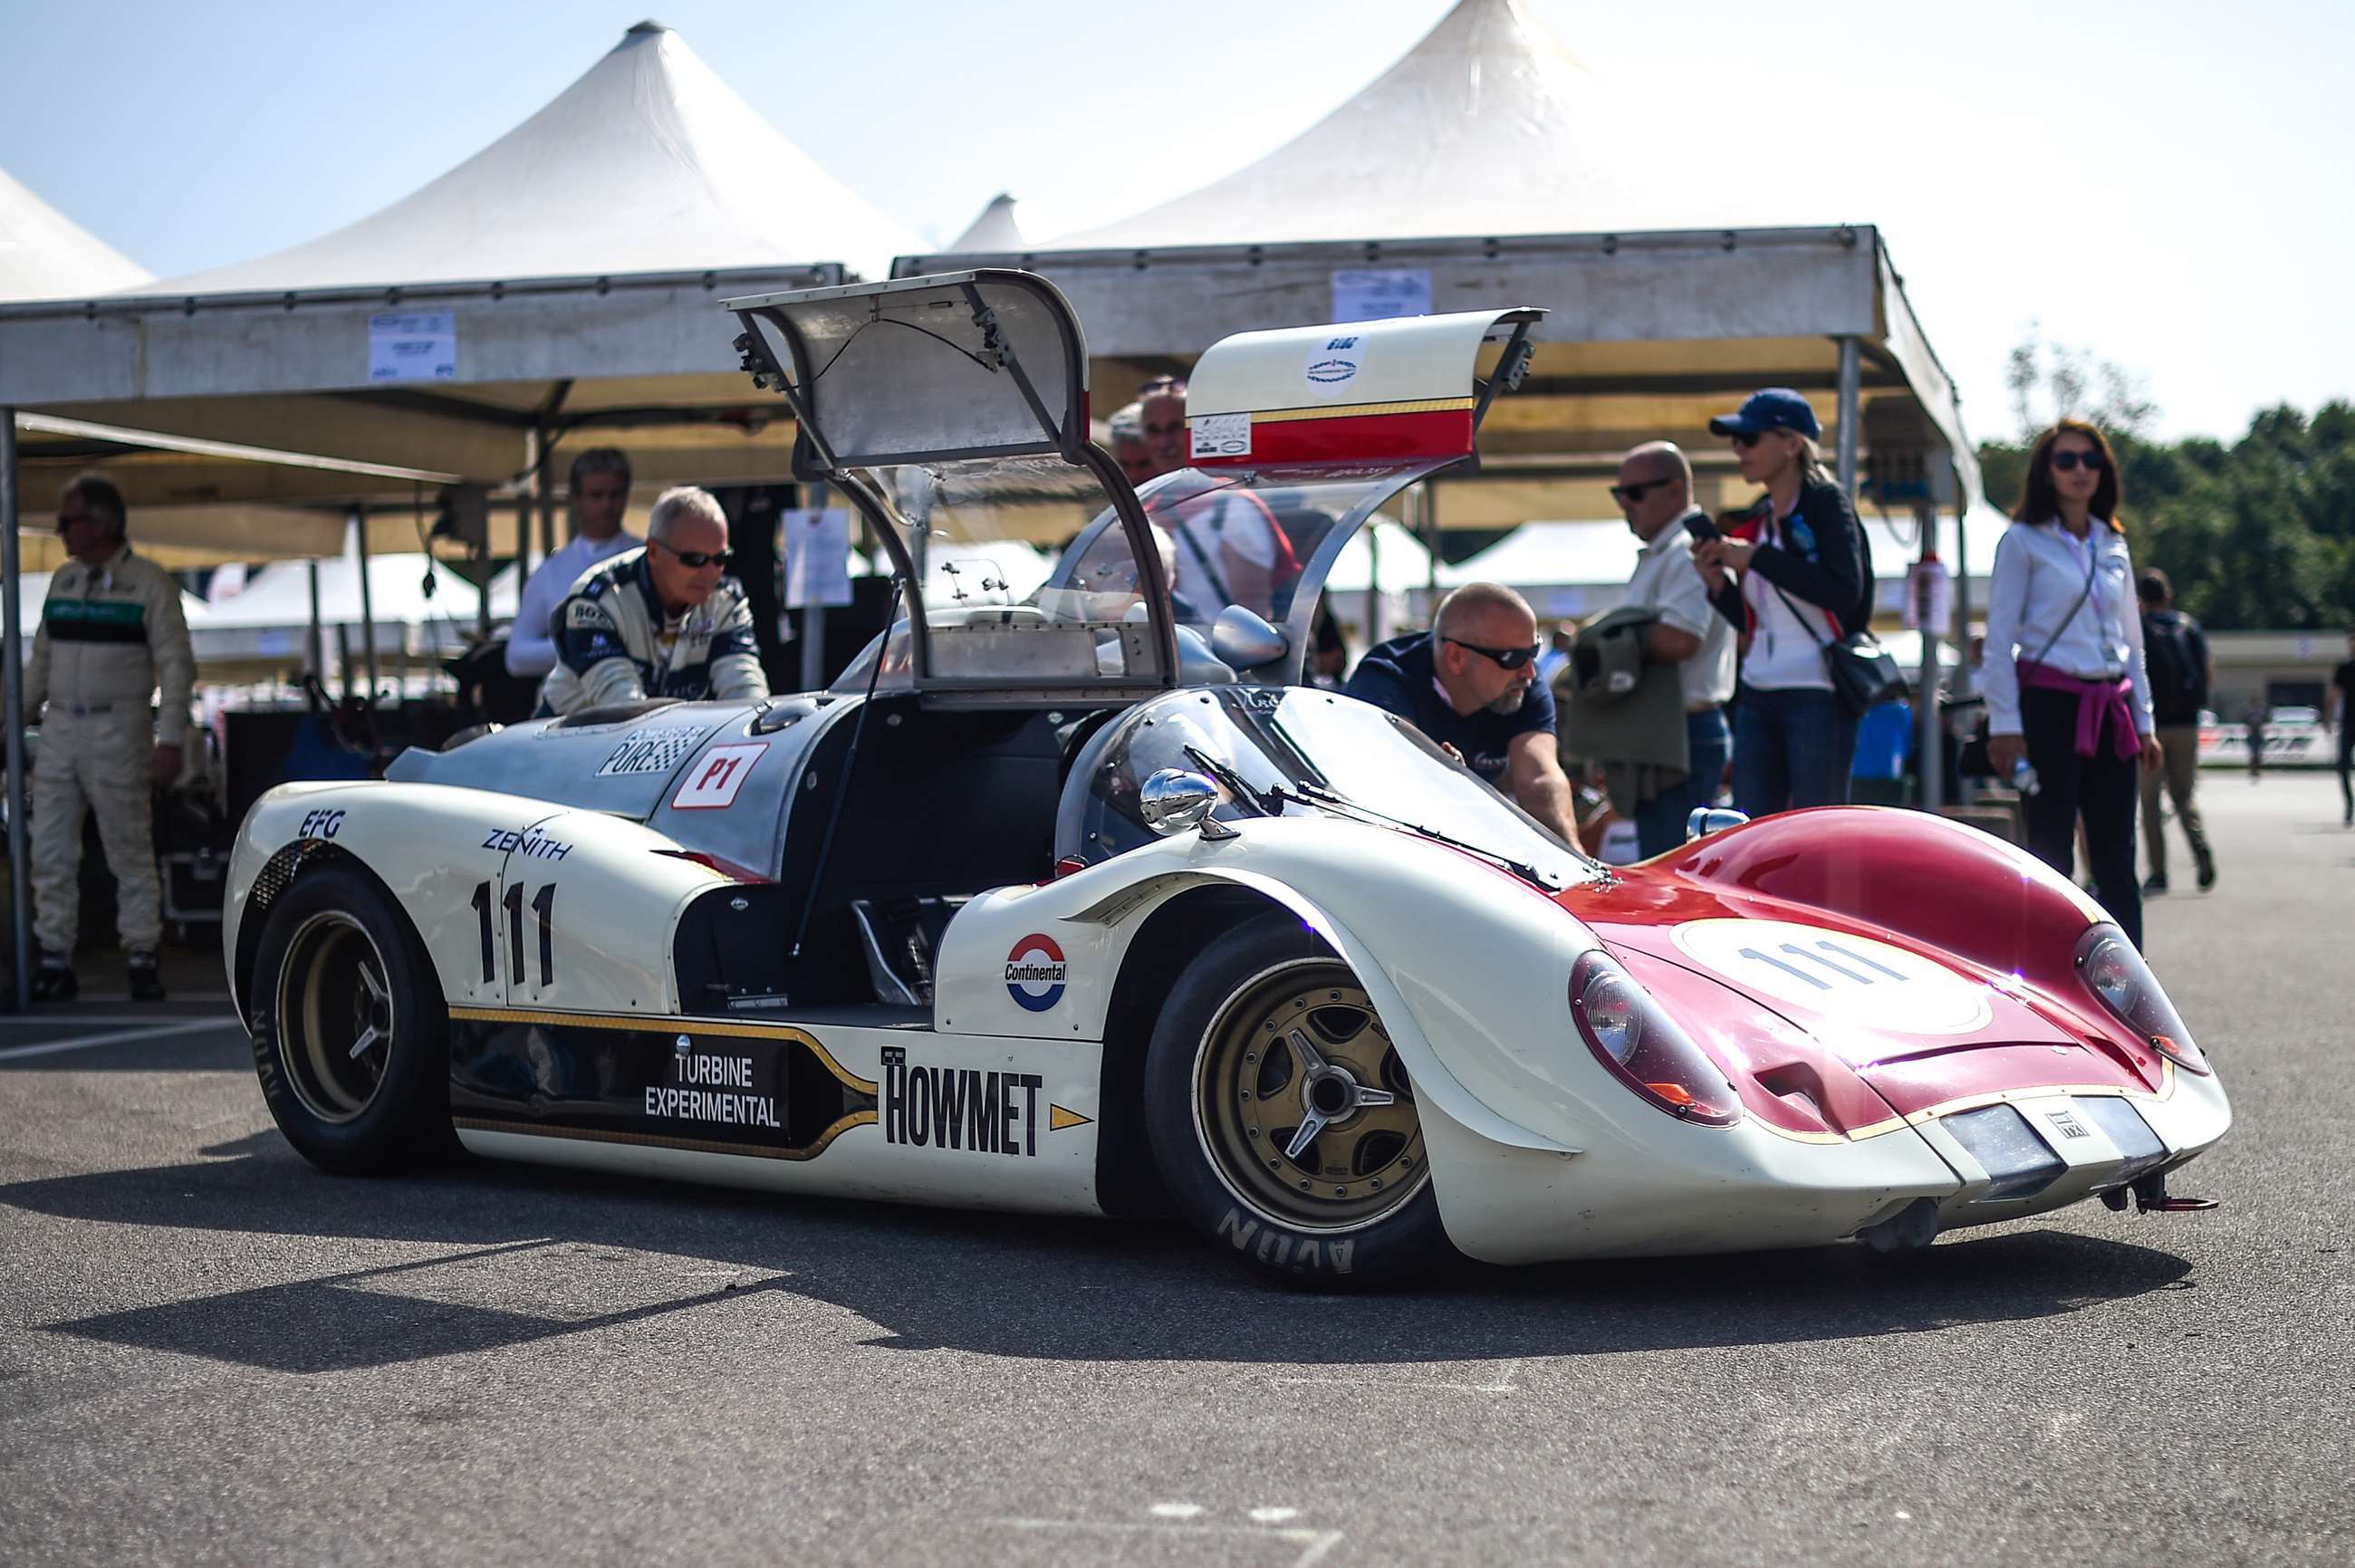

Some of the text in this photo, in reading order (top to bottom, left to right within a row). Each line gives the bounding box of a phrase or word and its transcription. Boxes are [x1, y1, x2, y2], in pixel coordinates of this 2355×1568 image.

[599, 738, 666, 774] PURE
[697, 756, 742, 791] P1
[298, 810, 346, 839] EFG
[482, 828, 573, 861] ZENITH
[471, 880, 557, 987] 111
[1004, 963, 1066, 982] Continental
[1738, 940, 1910, 990] 111
[675, 1053, 753, 1087] TURBINE
[645, 1086, 781, 1127] EXPERIMENTAL
[885, 1063, 1043, 1157] HOWMET
